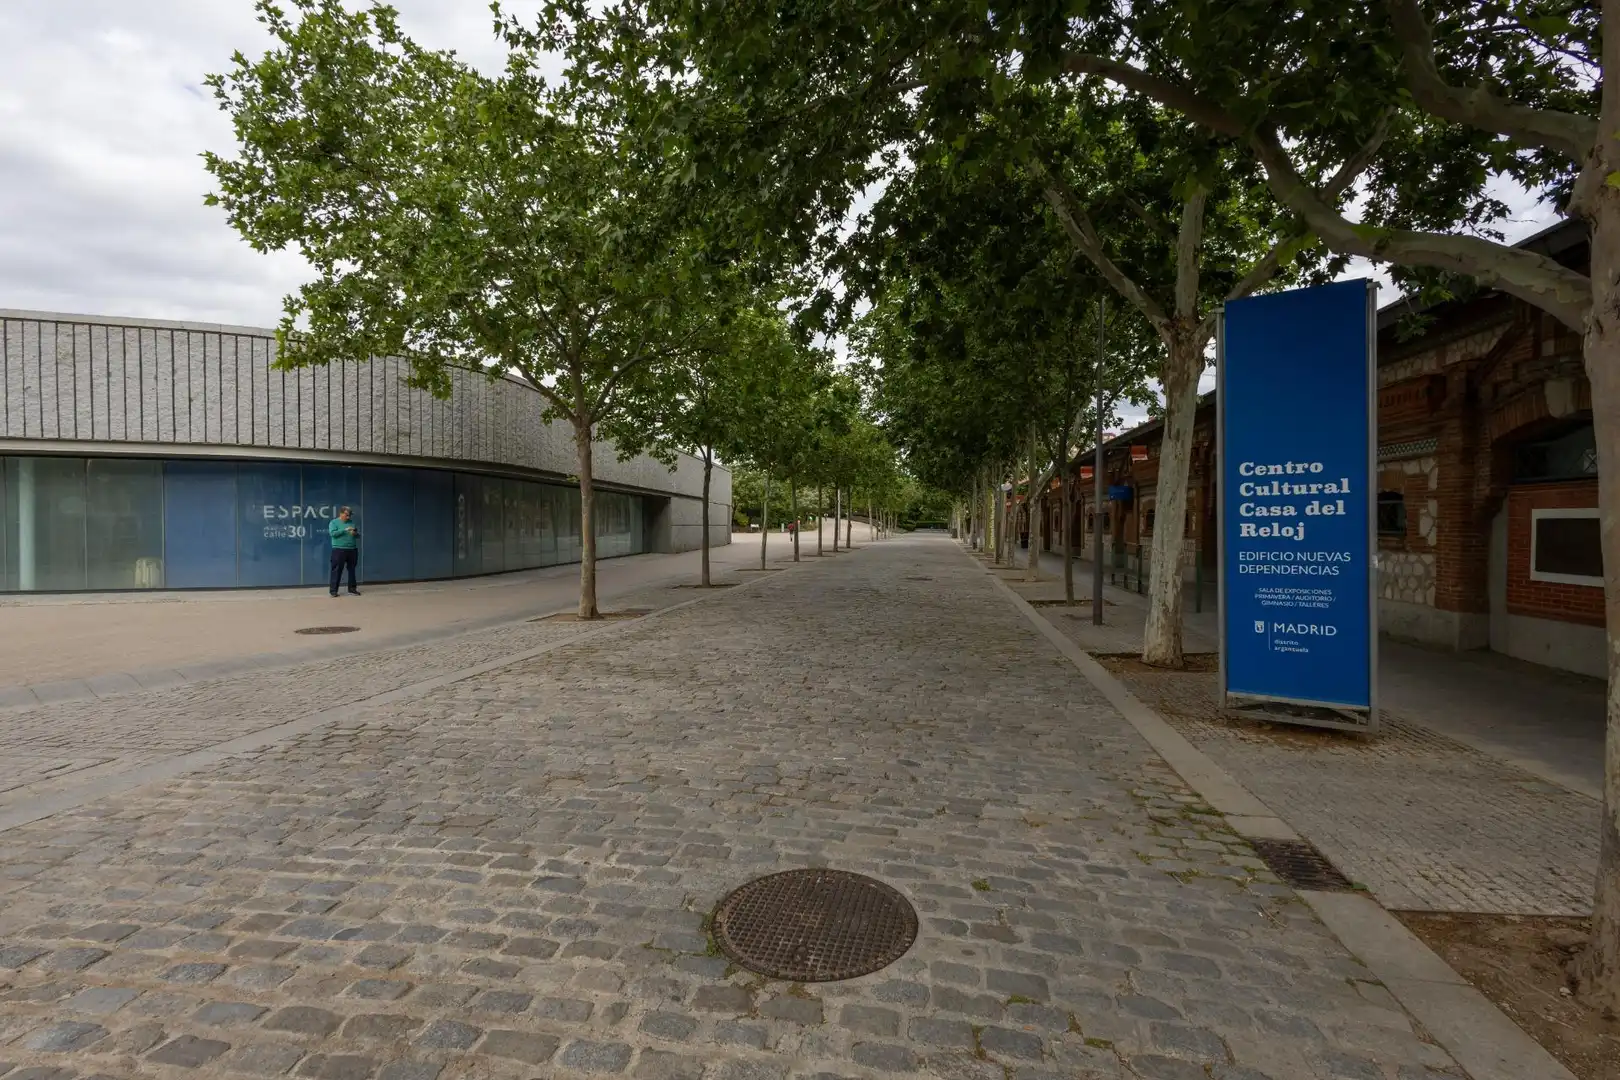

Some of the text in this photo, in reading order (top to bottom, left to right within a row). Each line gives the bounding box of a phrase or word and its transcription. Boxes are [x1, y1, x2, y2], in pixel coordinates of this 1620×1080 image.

[1239, 461, 1324, 477] Centro
[1239, 478, 1351, 497] Cultural
[263, 505, 354, 518] ESPACI
[1239, 500, 1346, 518] Casa del
[288, 525, 306, 538] 30
[1239, 522, 1305, 541] Reloj
[1239, 552, 1351, 562] EDIFICIO NUEVAS
[1239, 564, 1340, 576] DEPENDENCIAS
[1273, 622, 1337, 636] MADRID
